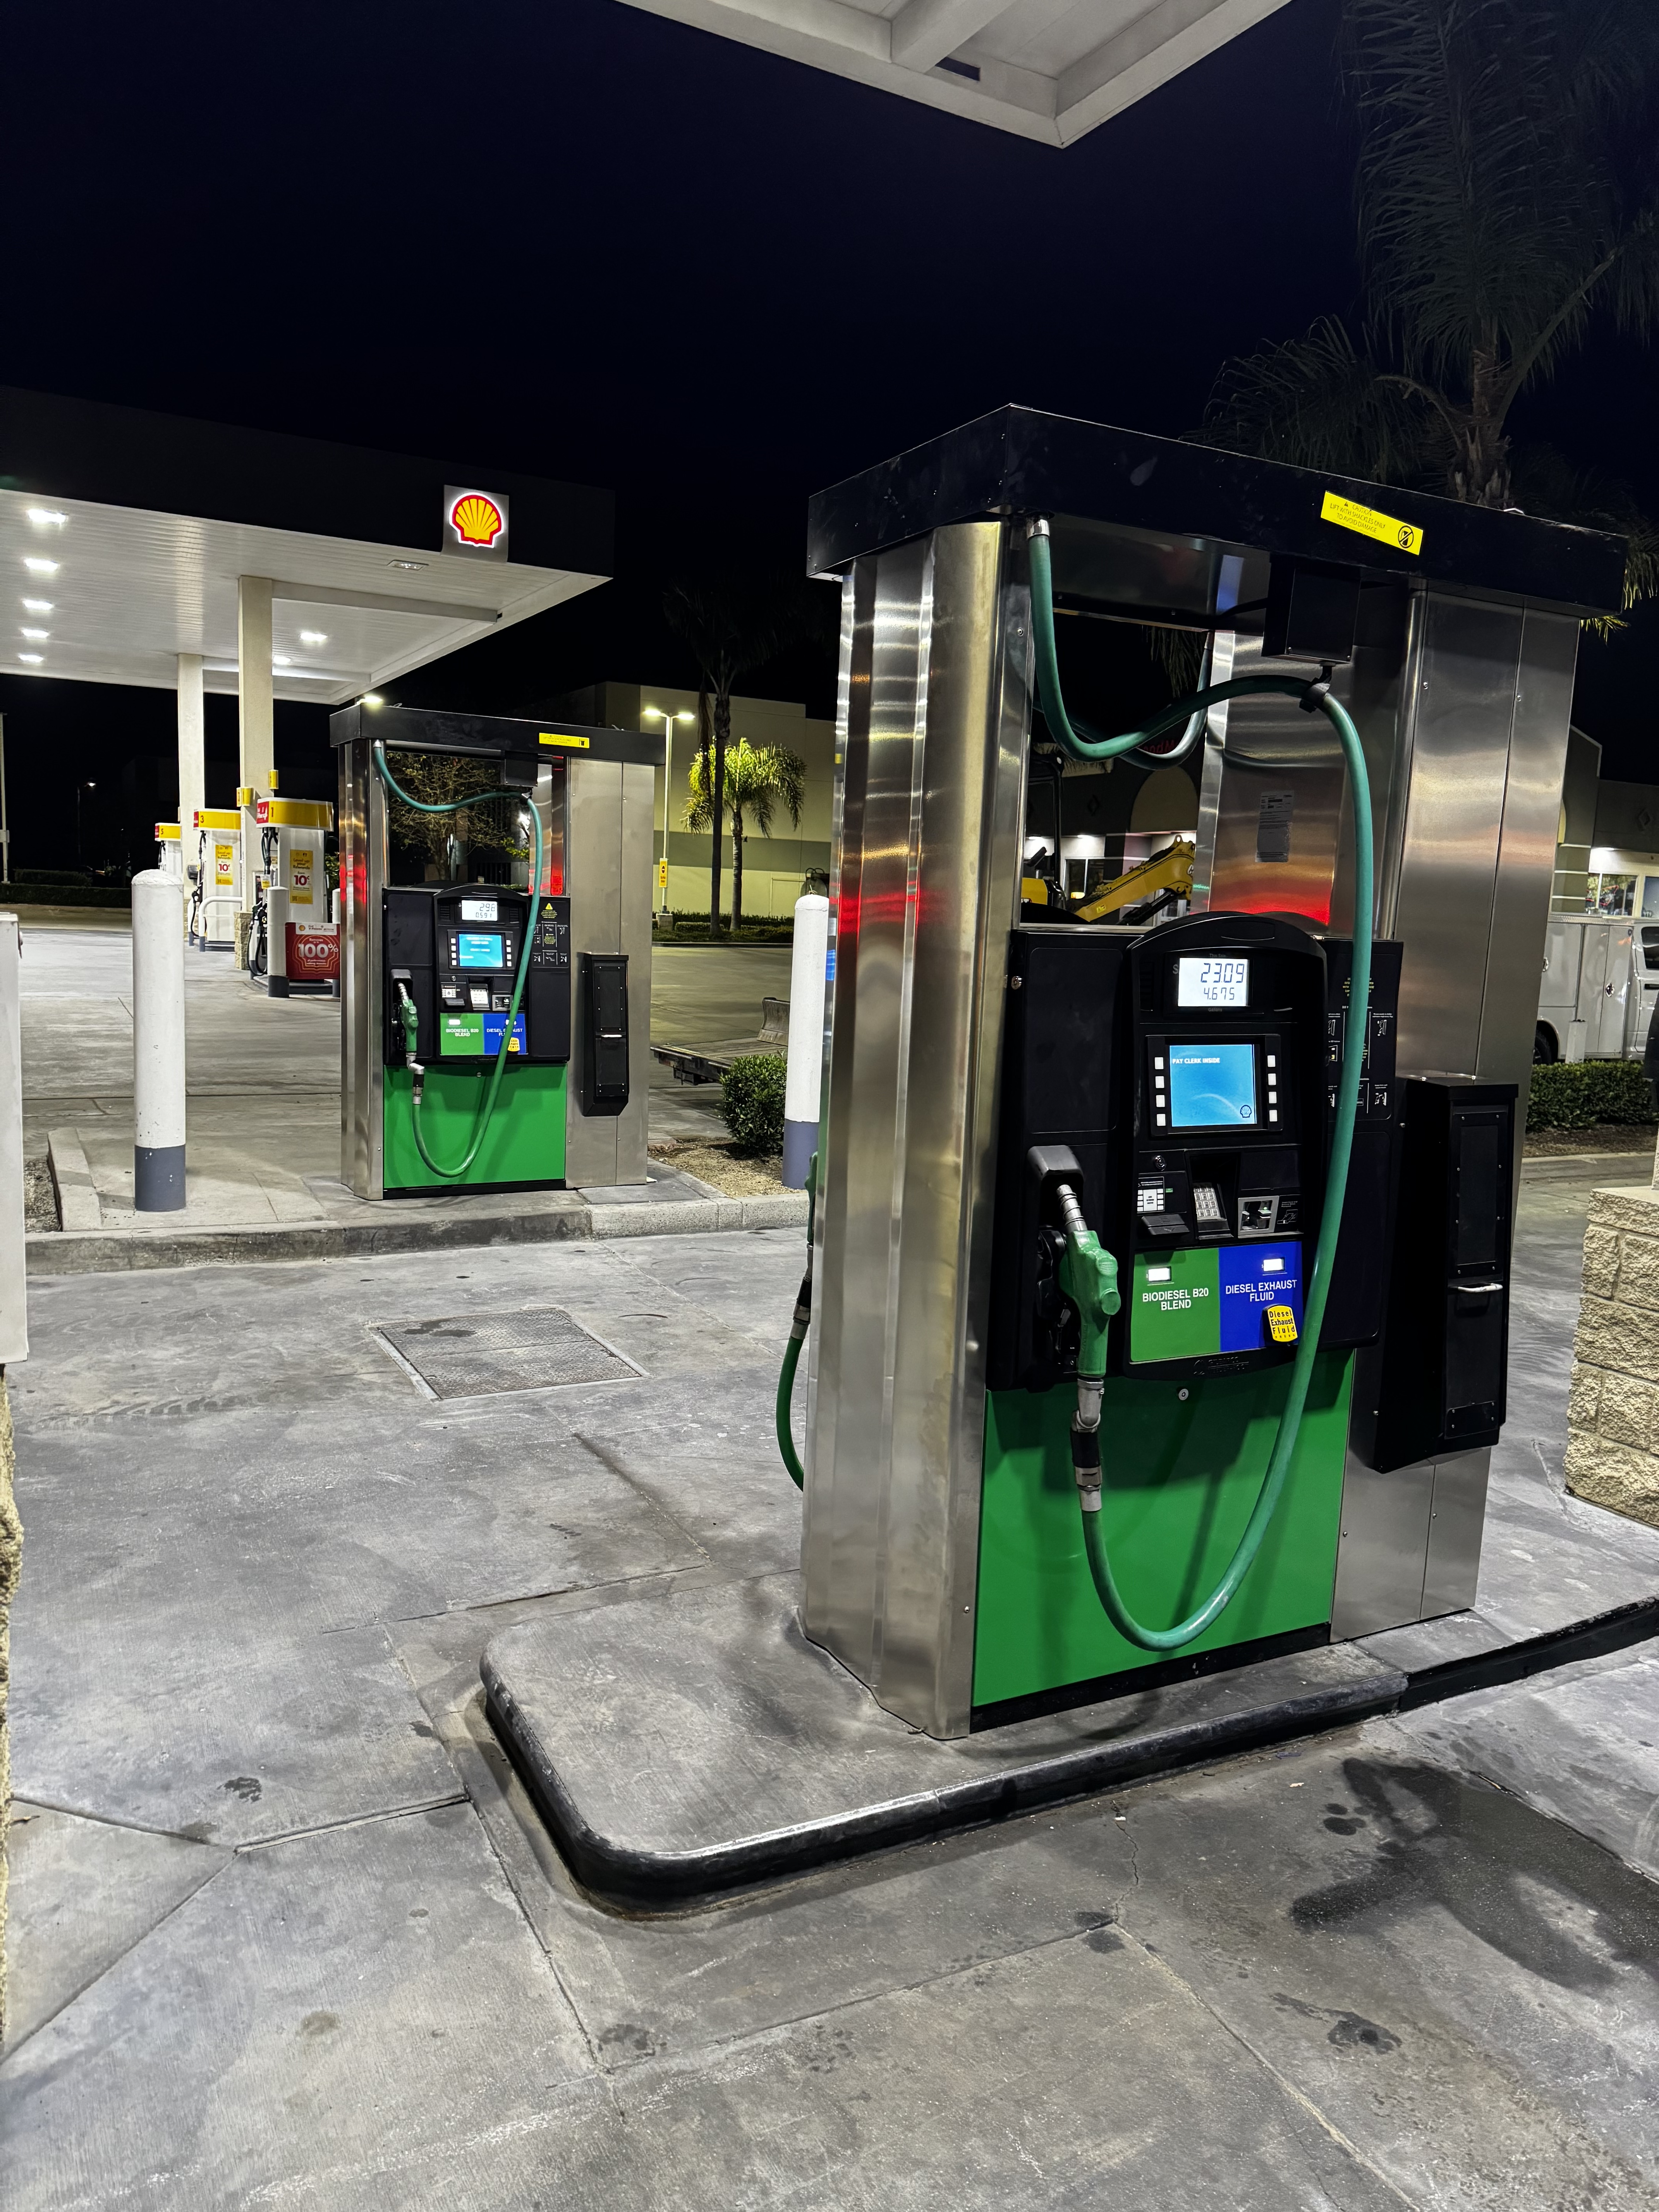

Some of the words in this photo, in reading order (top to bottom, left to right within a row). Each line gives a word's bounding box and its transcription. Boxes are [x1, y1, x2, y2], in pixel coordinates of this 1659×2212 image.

[271, 807, 273, 817] 1
[298, 943, 338, 958] 100%
[1204, 988, 1235, 1000] 4.675
[1226, 1283, 1256, 1294] DIESEL
[1259, 1279, 1297, 1291] EXHAUST
[1143, 1289, 1190, 1302] BIODIESEL
[1193, 1288, 1209, 1297] B20
[1250, 1292, 1274, 1302] FLUID
[1161, 1300, 1191, 1311] BLEND
[1269, 1309, 1291, 1318] Diesel
[1273, 1326, 1295, 1334] Fluid
